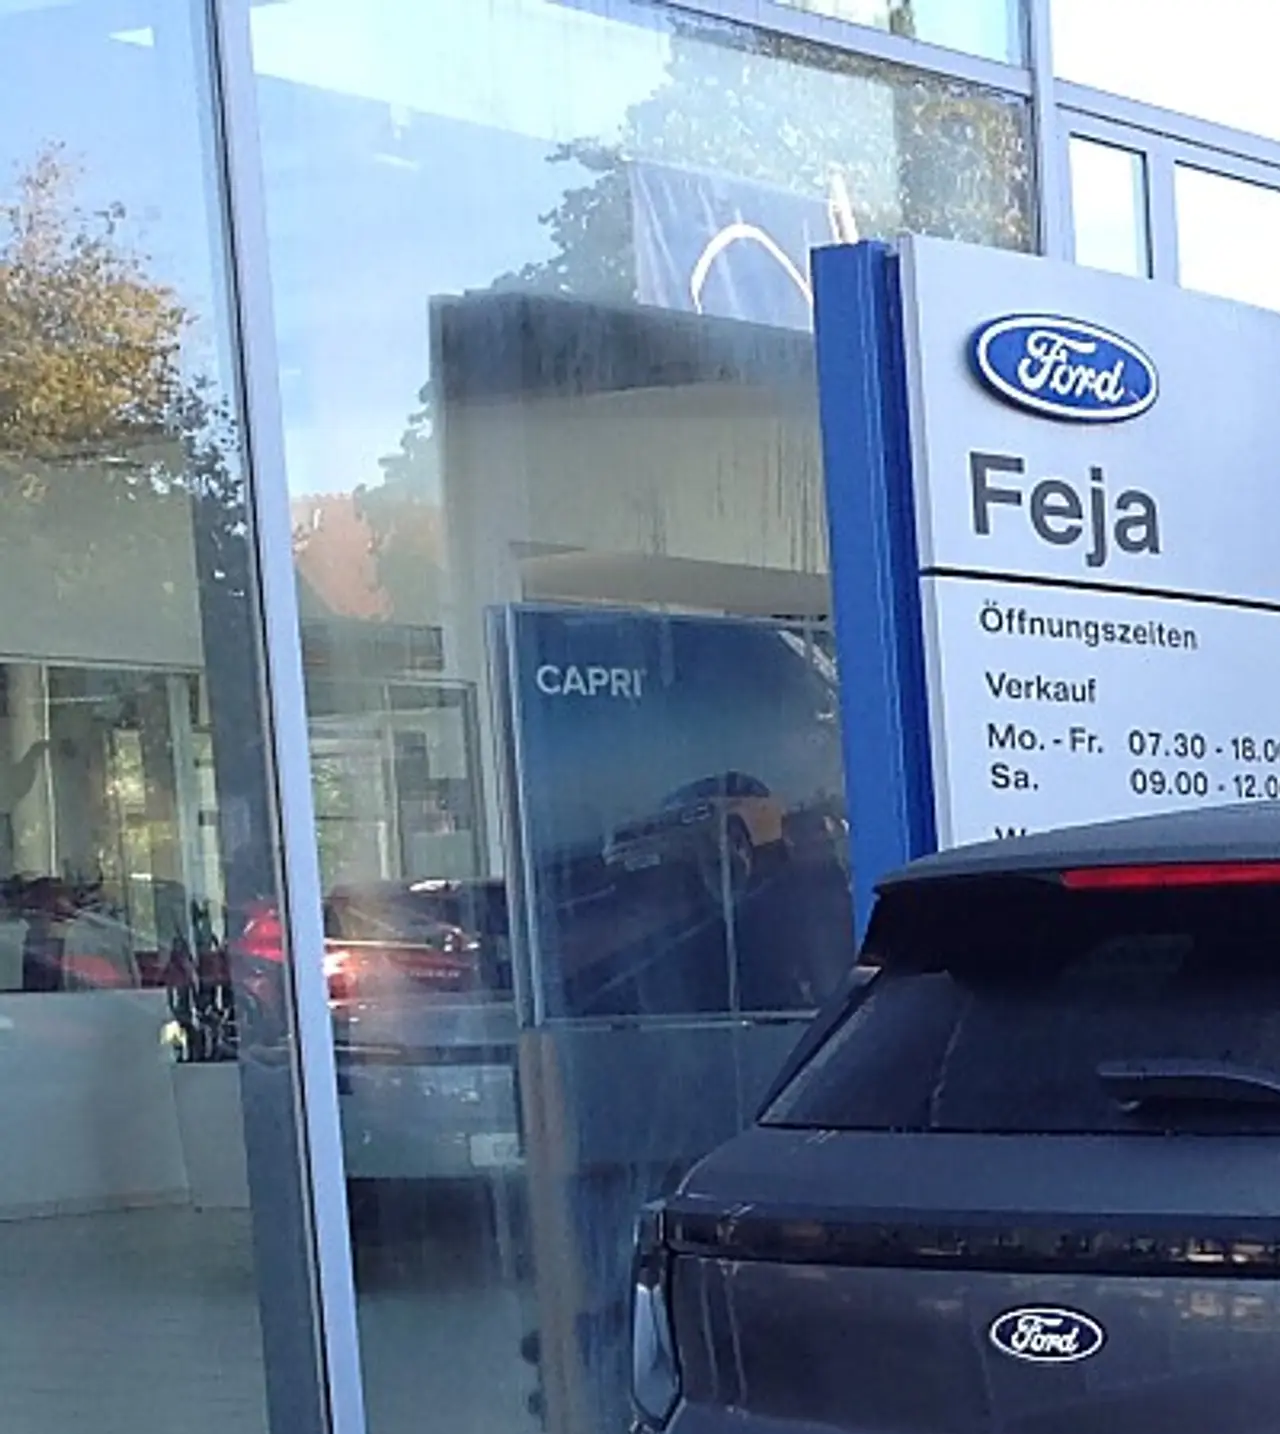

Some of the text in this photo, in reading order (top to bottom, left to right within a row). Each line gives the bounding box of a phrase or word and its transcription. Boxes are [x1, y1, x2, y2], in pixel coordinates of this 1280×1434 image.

[1017, 328, 1126, 405] Ford
[969, 450, 1161, 568] Feja
[978, 601, 1199, 651] Öffnungszeiten
[536, 664, 643, 698] CAPRI
[984, 671, 1097, 704] Verkauf
[986, 722, 1045, 753] Mo.
[1069, 727, 1104, 755] Fr.
[1128, 729, 1207, 760] 07.30
[990, 763, 1040, 791] Sa.
[1130, 767, 1209, 797] 09.00
[1011, 1314, 1080, 1354] Ford
